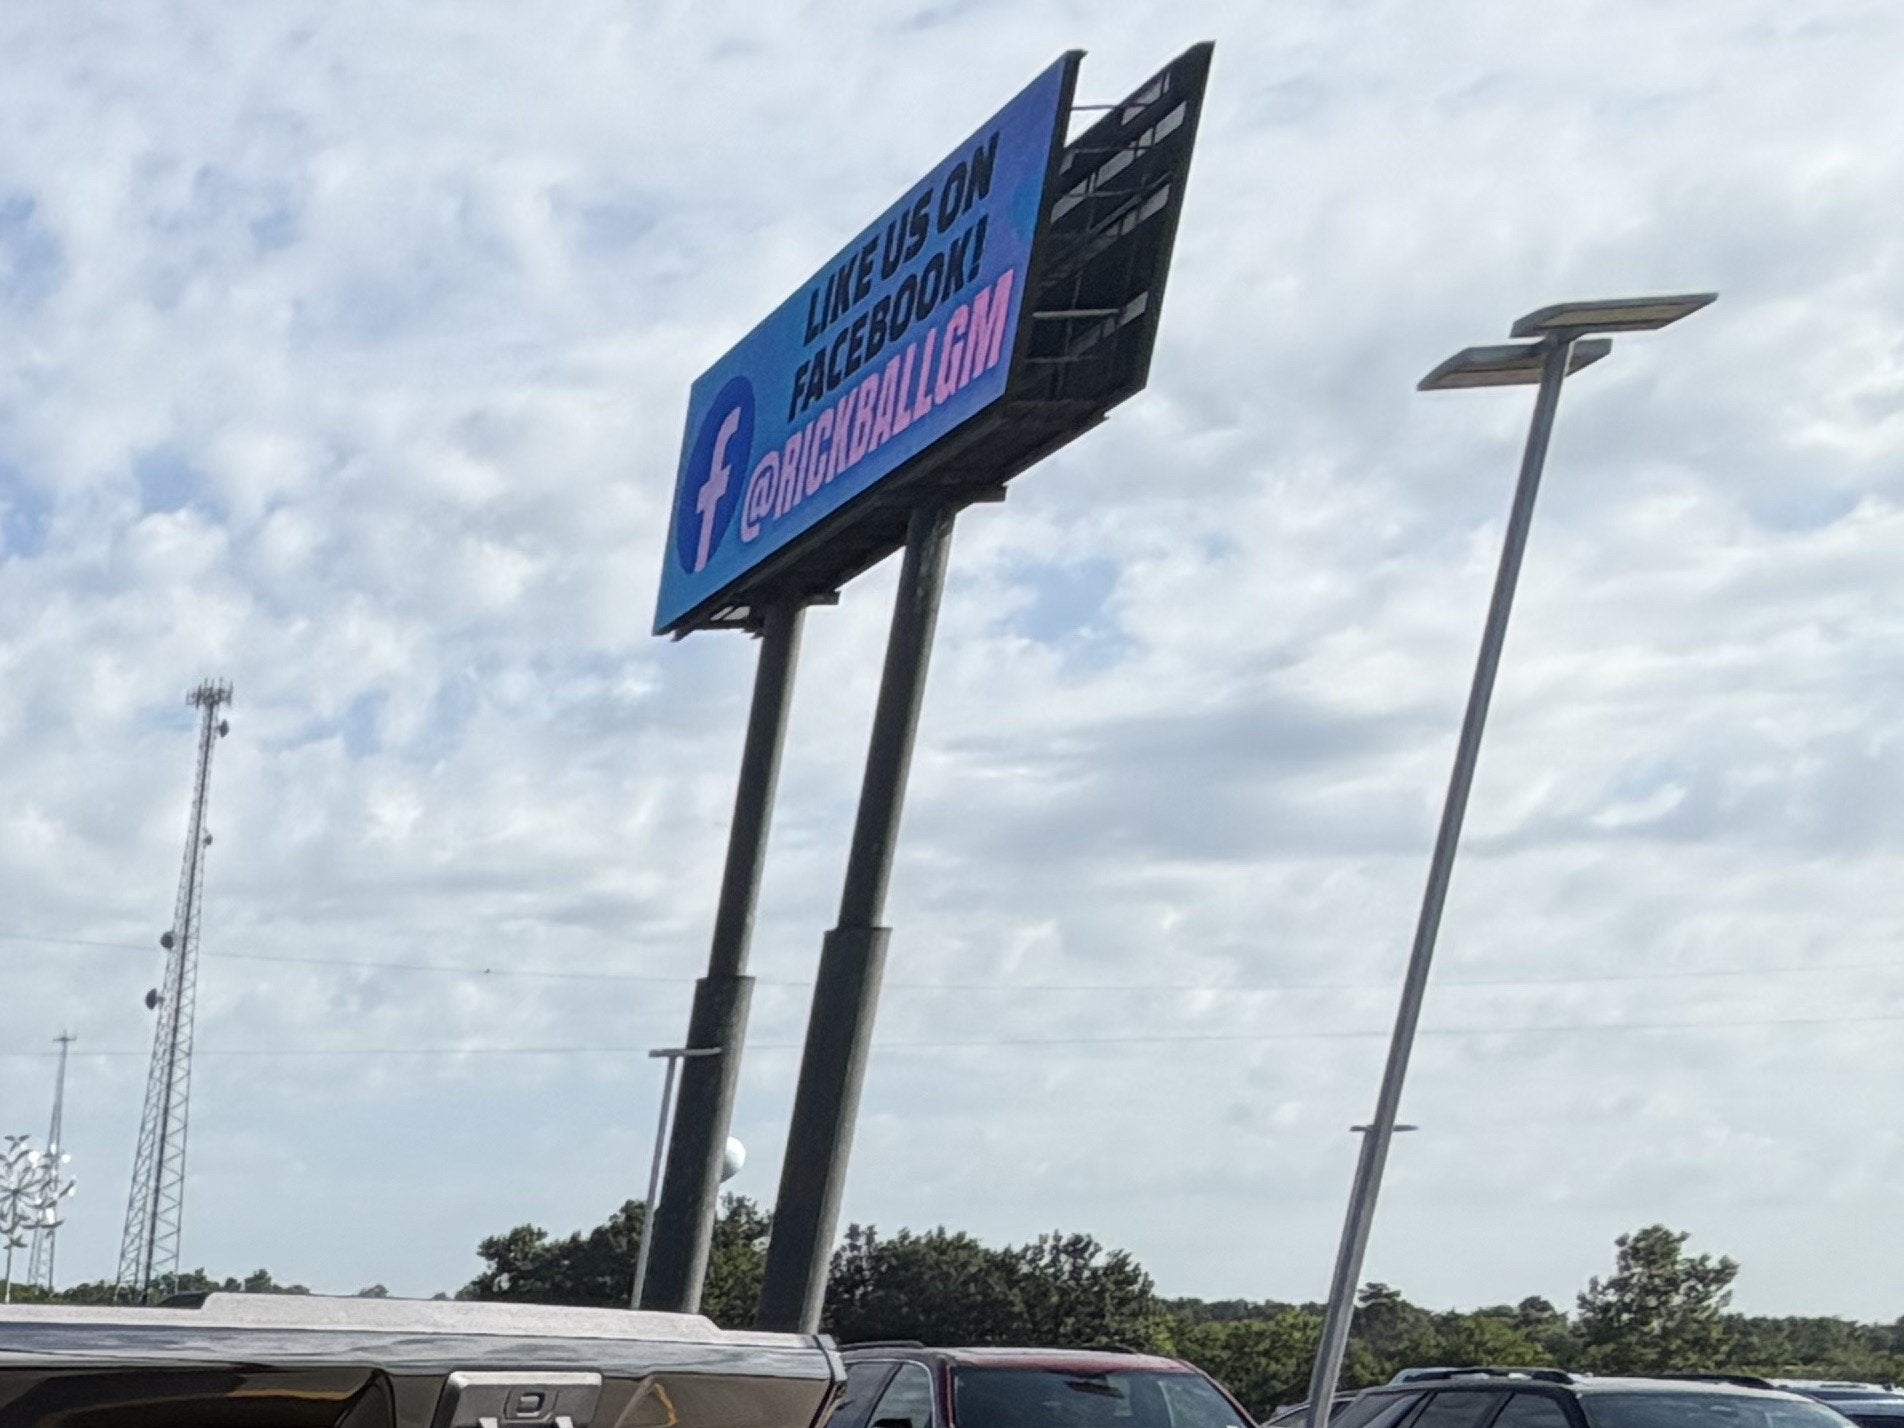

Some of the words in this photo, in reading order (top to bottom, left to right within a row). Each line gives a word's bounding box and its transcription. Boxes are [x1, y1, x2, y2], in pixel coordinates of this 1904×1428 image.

[788, 214, 989, 423] FACEBOOK!
[803, 236, 882, 347] LIKE
[882, 186, 933, 281] US
[936, 132, 1000, 236] ON
[740, 268, 1014, 543] @RICKBALLGM
